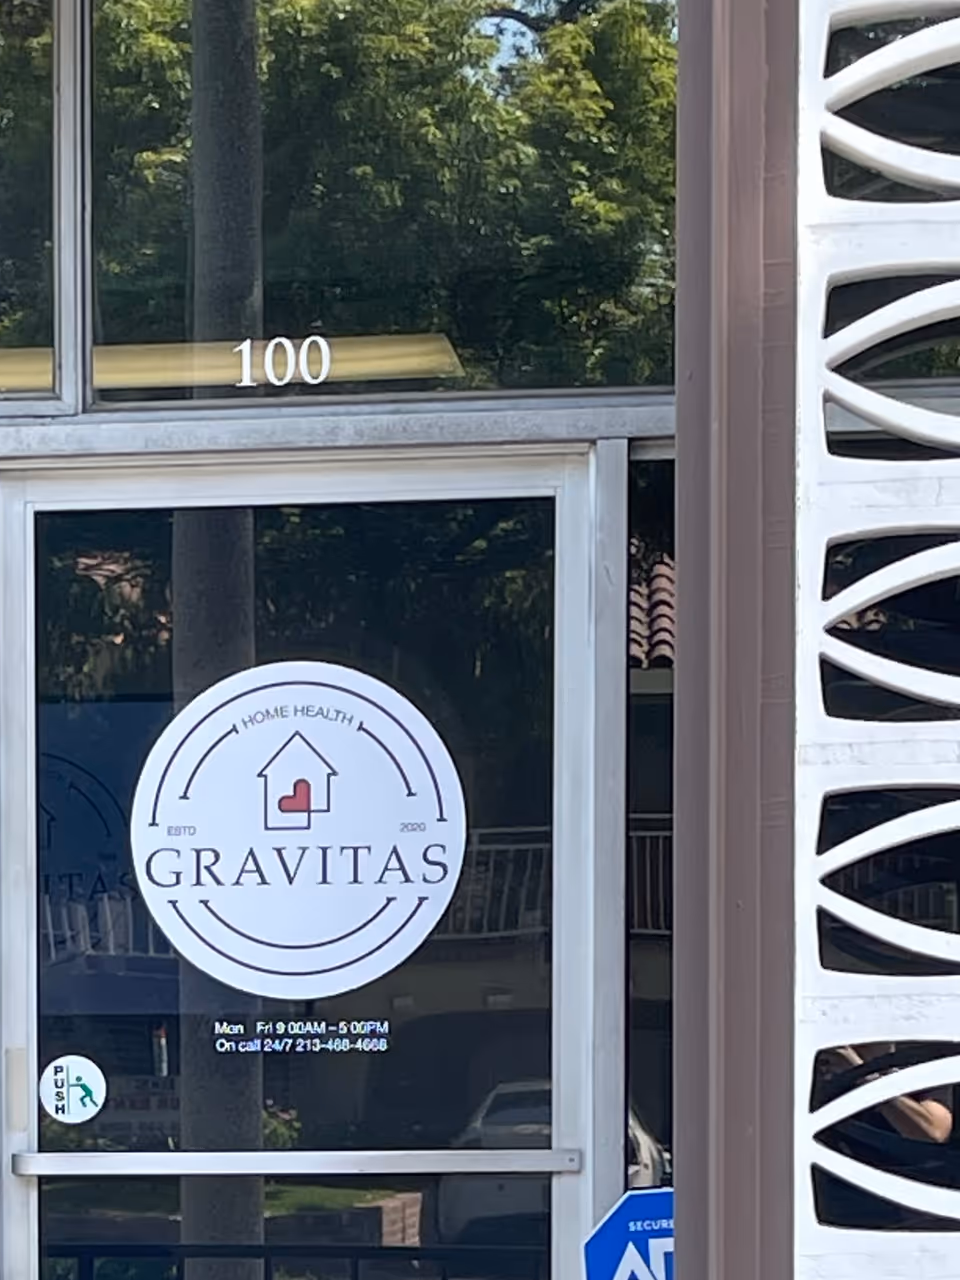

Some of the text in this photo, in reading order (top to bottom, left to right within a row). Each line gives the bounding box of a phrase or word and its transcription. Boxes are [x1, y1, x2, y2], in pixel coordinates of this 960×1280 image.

[232, 335, 331, 387] 100
[241, 704, 354, 729] HOME HEALTH
[399, 822, 426, 833] 2020
[145, 844, 450, 887] GRAVITAS
[214, 1021, 245, 1035] Mon
[255, 1021, 273, 1035] Fri
[215, 1039, 236, 1052] On
[239, 1039, 261, 1052] call
[263, 1038, 292, 1052] 24/7
[53, 1065, 66, 1115] PUSH
[628, 1219, 674, 1231] SECURE
